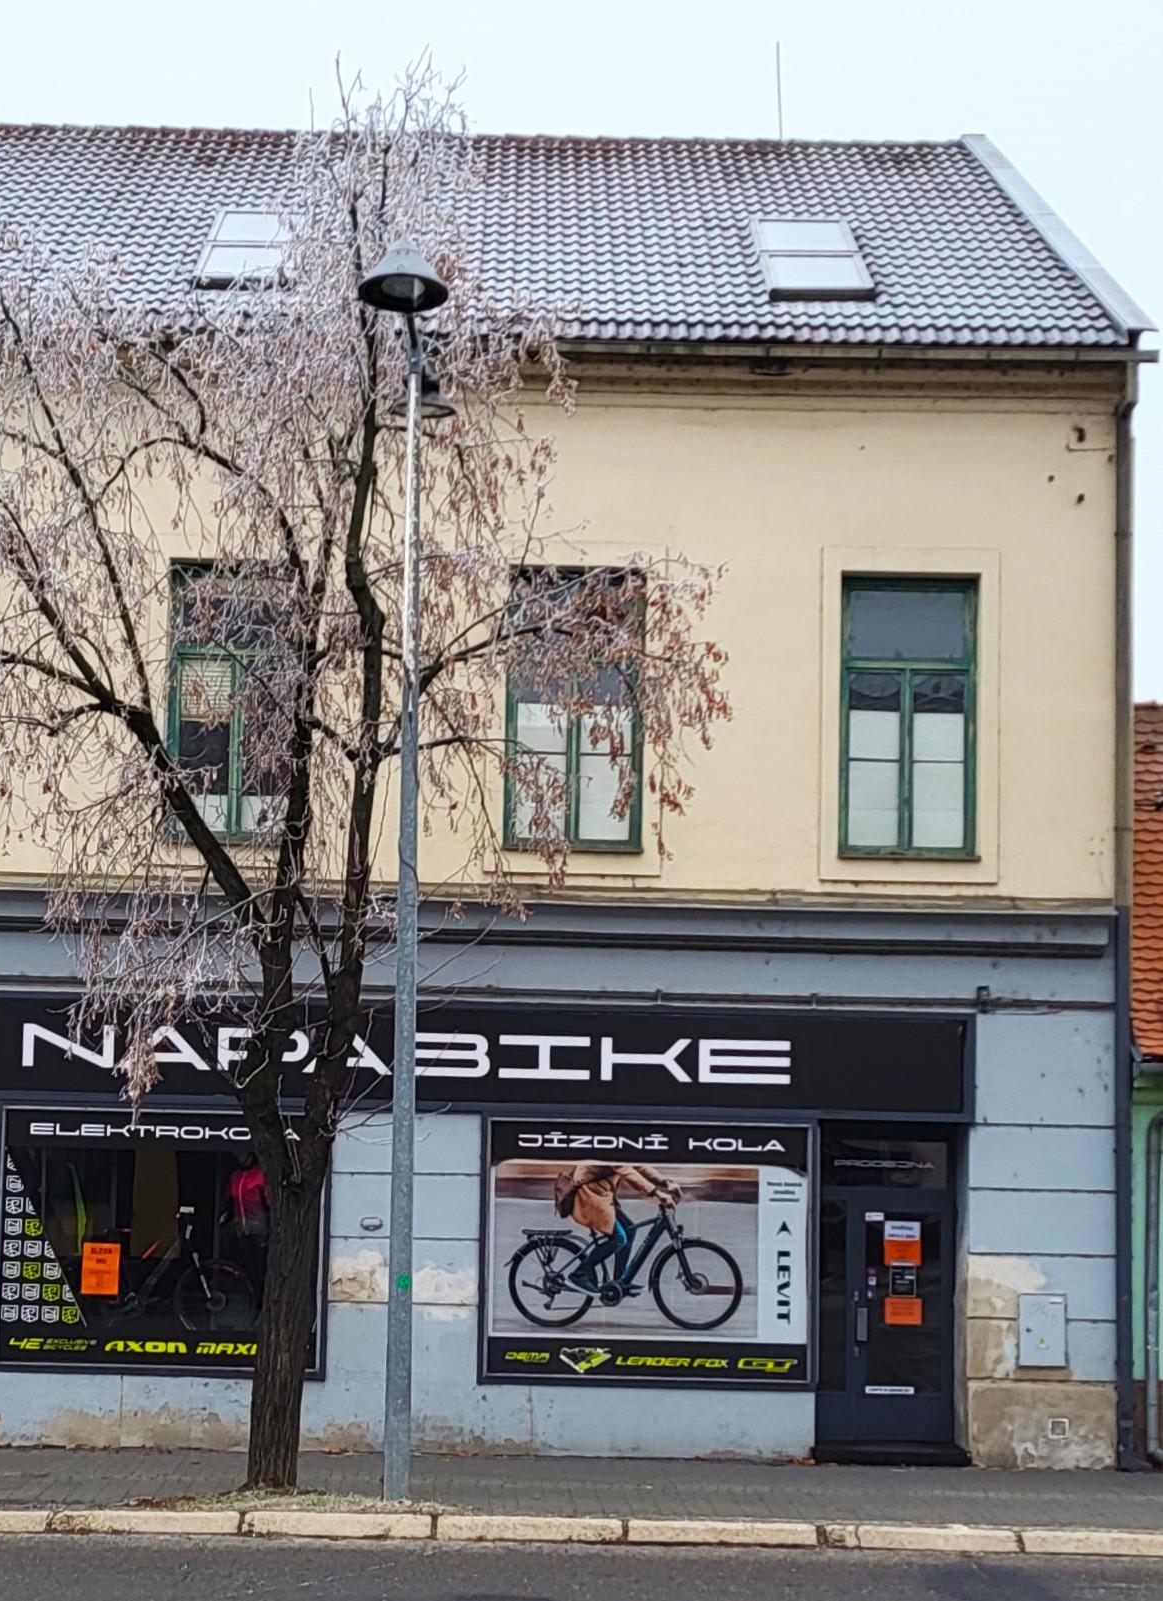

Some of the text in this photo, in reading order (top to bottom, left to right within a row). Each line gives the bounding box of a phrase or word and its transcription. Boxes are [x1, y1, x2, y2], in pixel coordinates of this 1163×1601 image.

[29, 1121, 302, 1142] ELEKTROKOA
[518, 1131, 786, 1152] JÍZDNÍ KOLA
[777, 1250, 791, 1326] LEVIT
[104, 1340, 188, 1353] AXON
[615, 1355, 729, 1368] LEADER FOX
